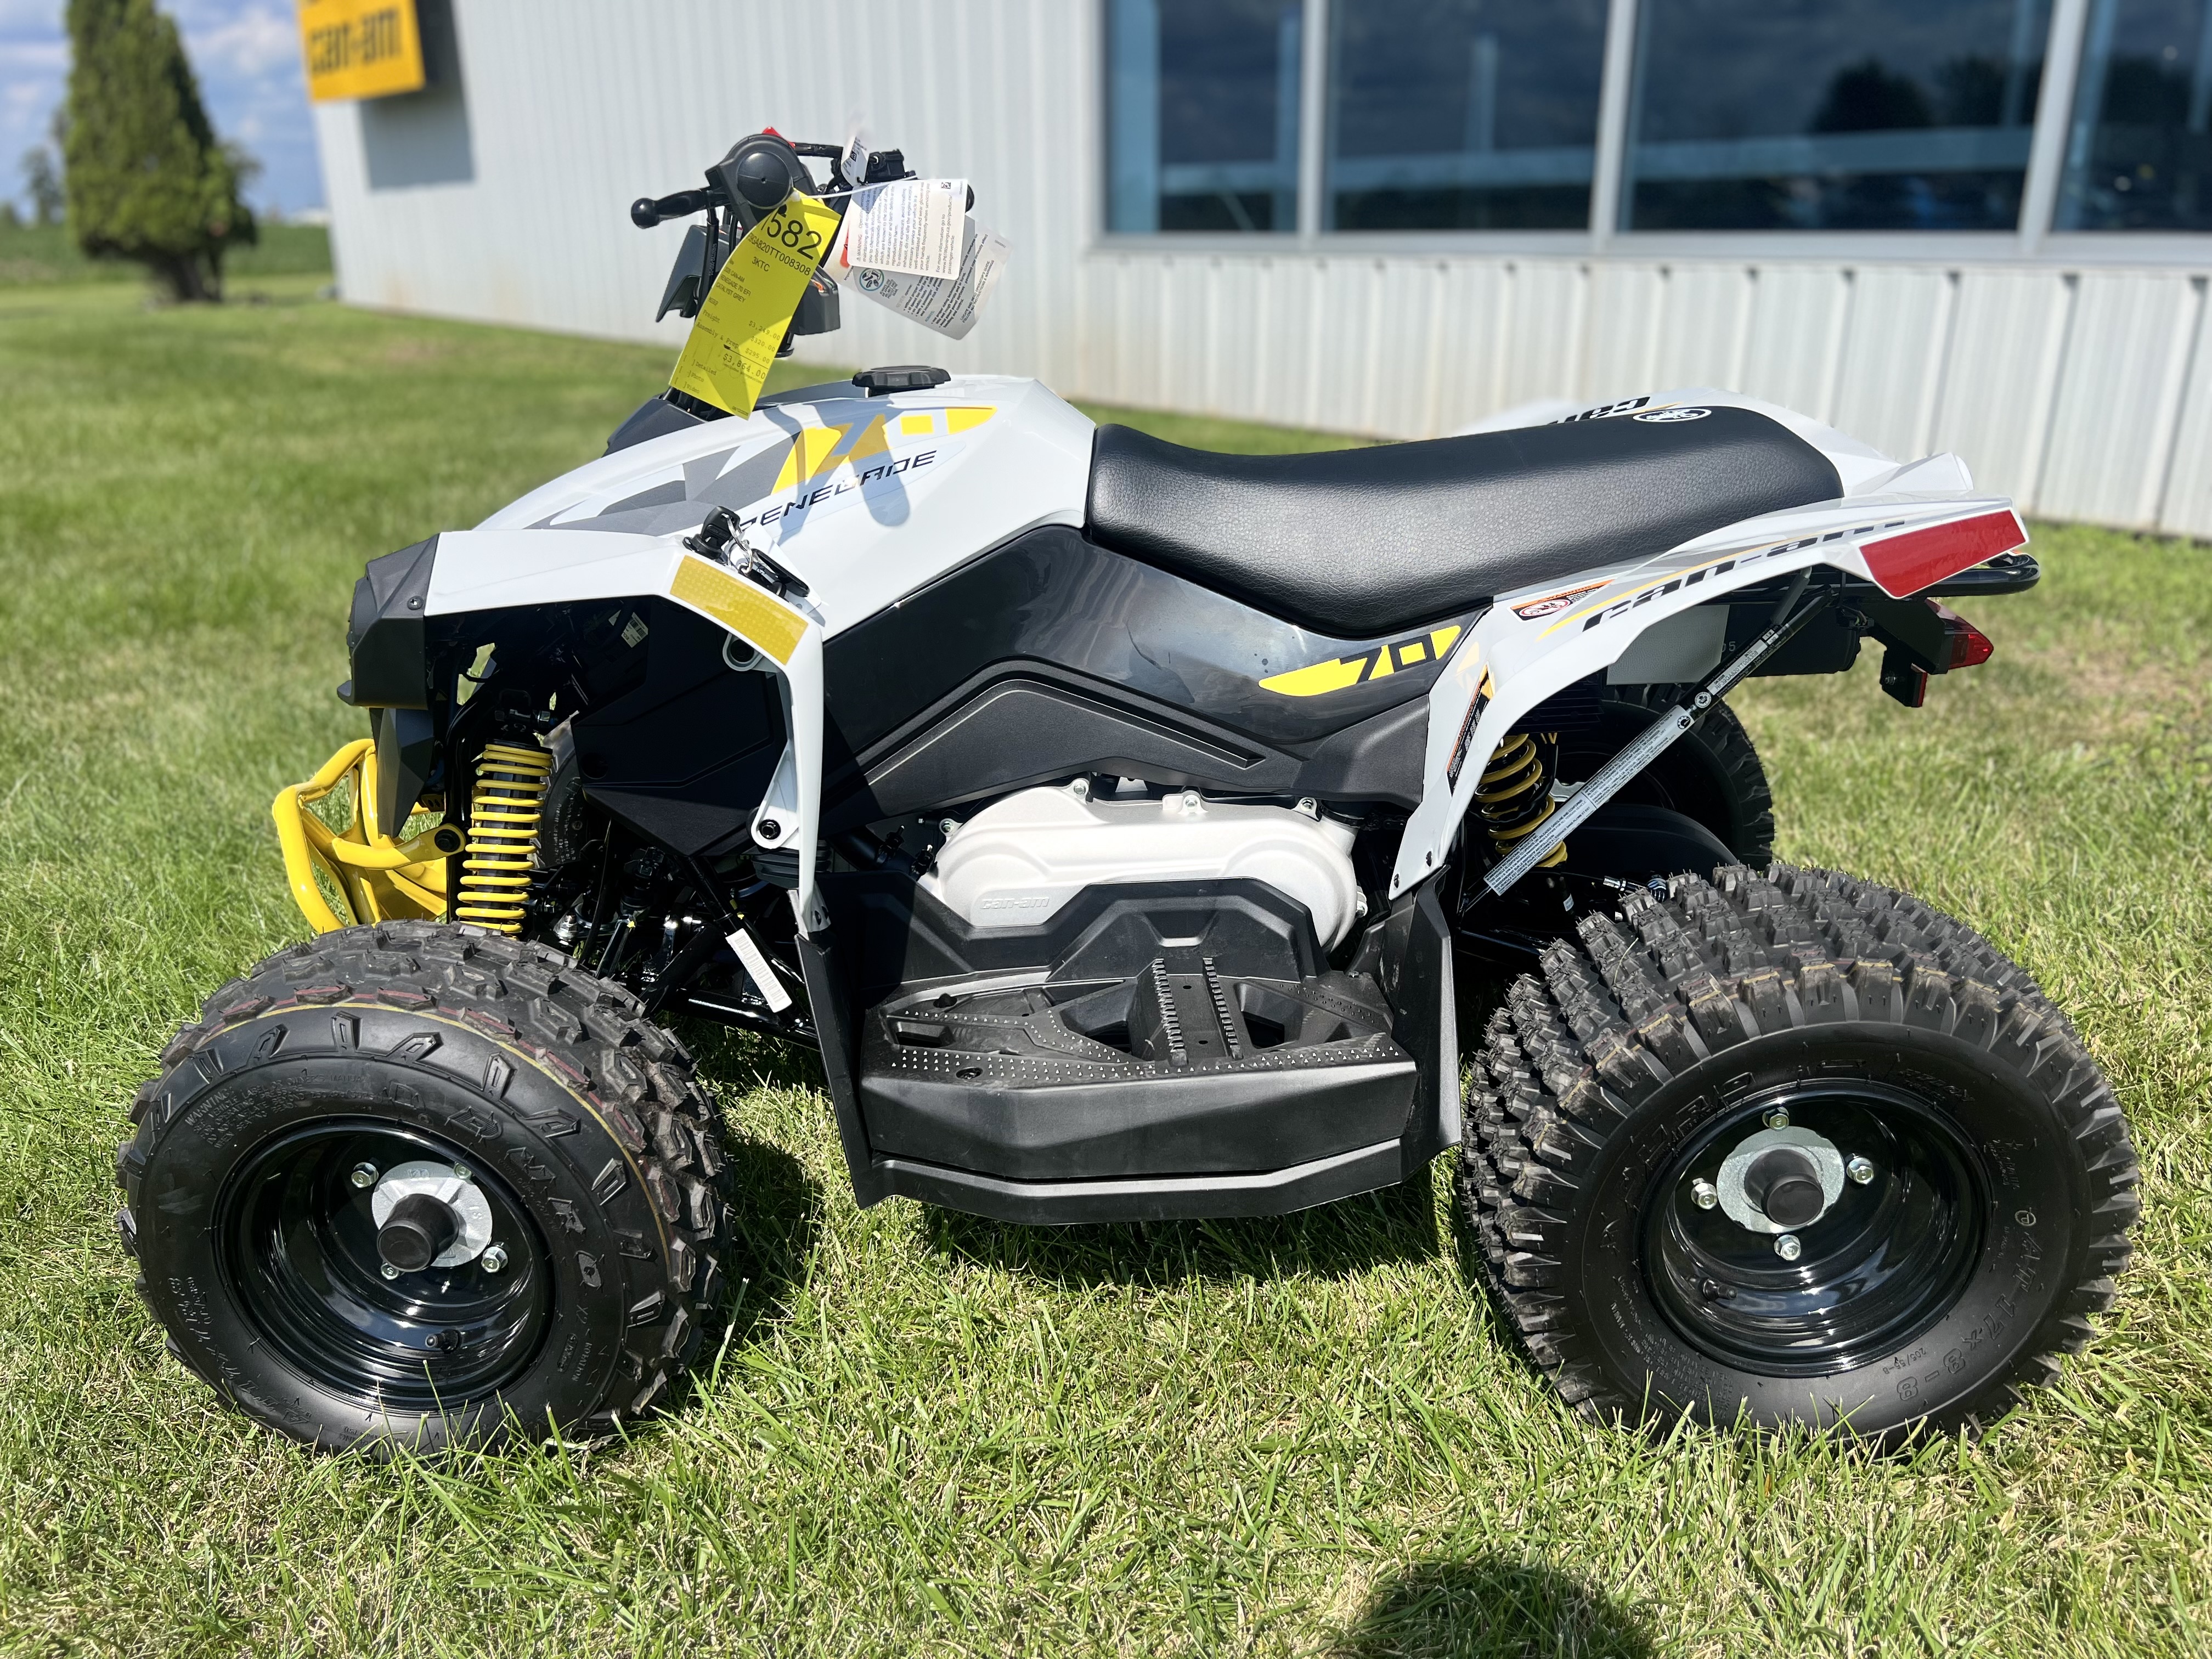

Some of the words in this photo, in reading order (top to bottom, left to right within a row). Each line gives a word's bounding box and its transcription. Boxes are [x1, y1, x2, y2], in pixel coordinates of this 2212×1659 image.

[752, 256, 770, 272] 3KTC
[716, 282, 733, 296] CATALYST
[733, 292, 746, 303] GREY
[696, 321, 718, 338] Assembly
[726, 338, 740, 349] Prep
[745, 348, 770, 364] $295.00
[703, 309, 720, 324] Freight
[751, 336, 776, 352] $320.00
[748, 320, 780, 341] $3,249.00
[723, 353, 766, 380] $3,864.00
[1339, 633, 1437, 684] 70
